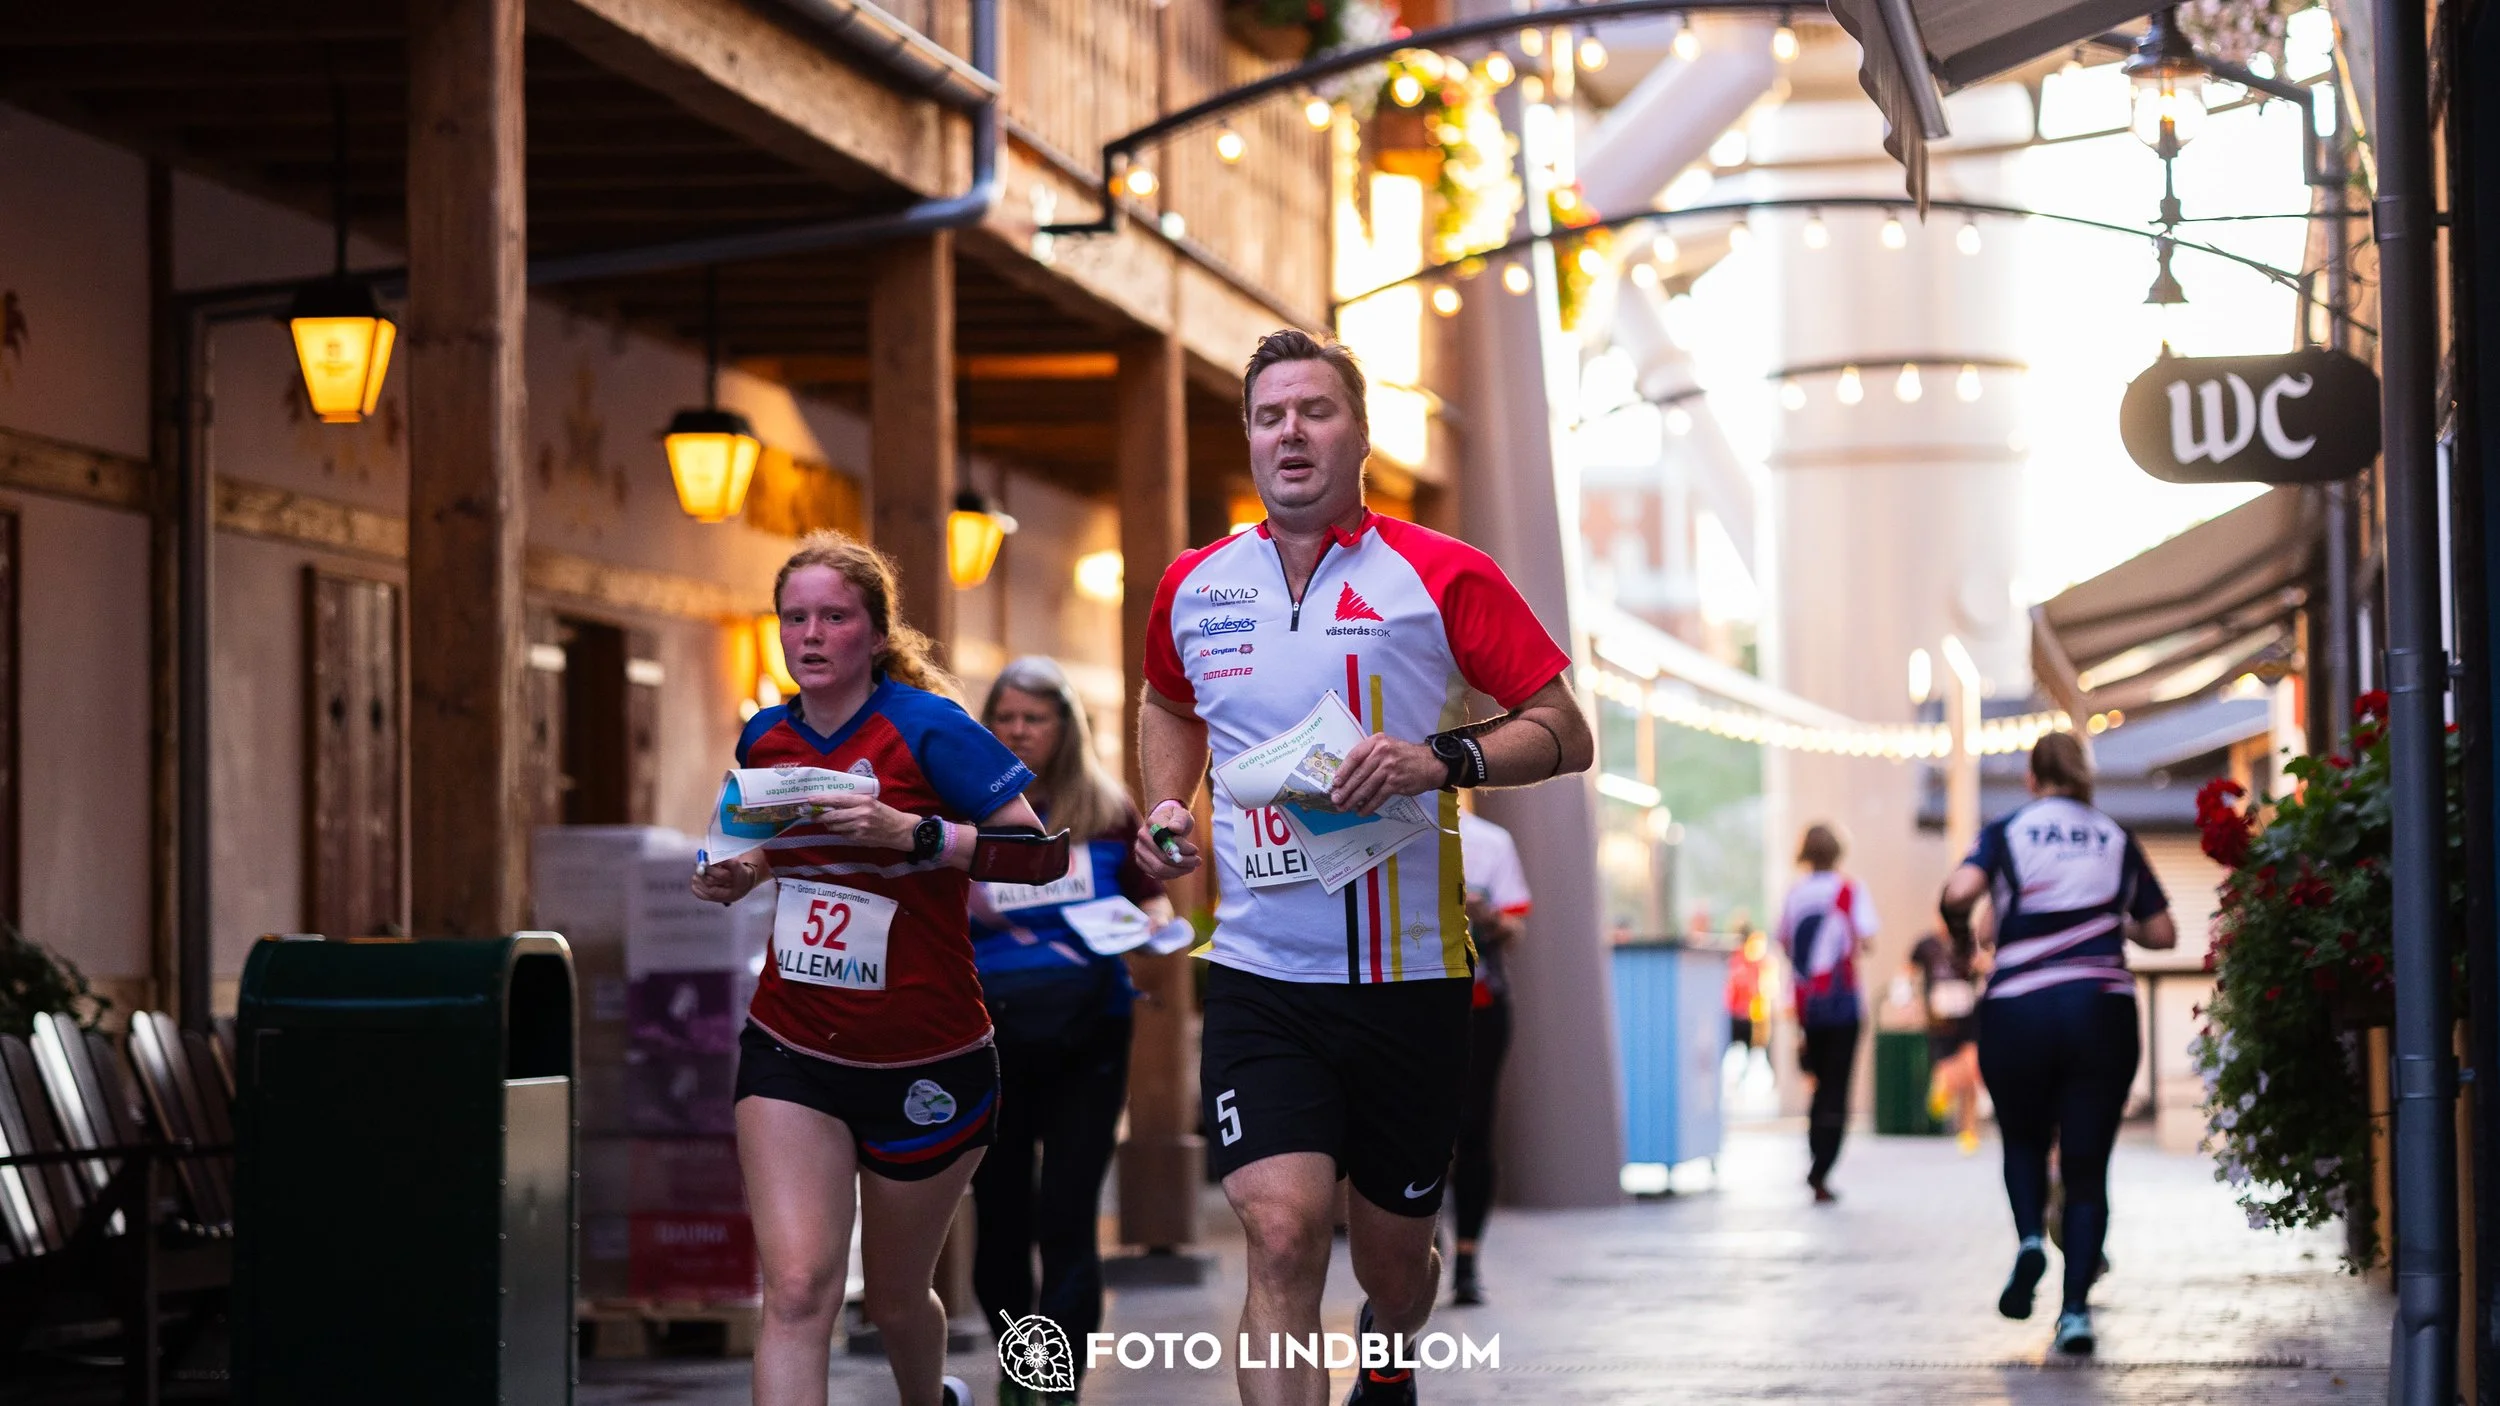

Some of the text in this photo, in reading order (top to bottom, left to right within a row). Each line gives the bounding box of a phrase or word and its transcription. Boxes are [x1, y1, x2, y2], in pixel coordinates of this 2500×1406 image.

[2167, 371, 2317, 464] WC
[1210, 588, 1258, 602] INVID
[1203, 667, 1253, 681] noname
[1238, 716, 1323, 770] Gröna Lund-sprinten
[1264, 747, 1298, 766] september
[1462, 738, 1485, 779] noname
[766, 785, 824, 796] Lund-sprinten
[798, 776, 832, 784] september
[990, 777, 1005, 793] OK
[2027, 822, 2112, 845] TÄBY
[818, 888, 870, 904] Lund-sprinten
[802, 899, 852, 951] 52
[778, 949, 878, 985] ALLEMAN
[1216, 1089, 1242, 1147] 5
